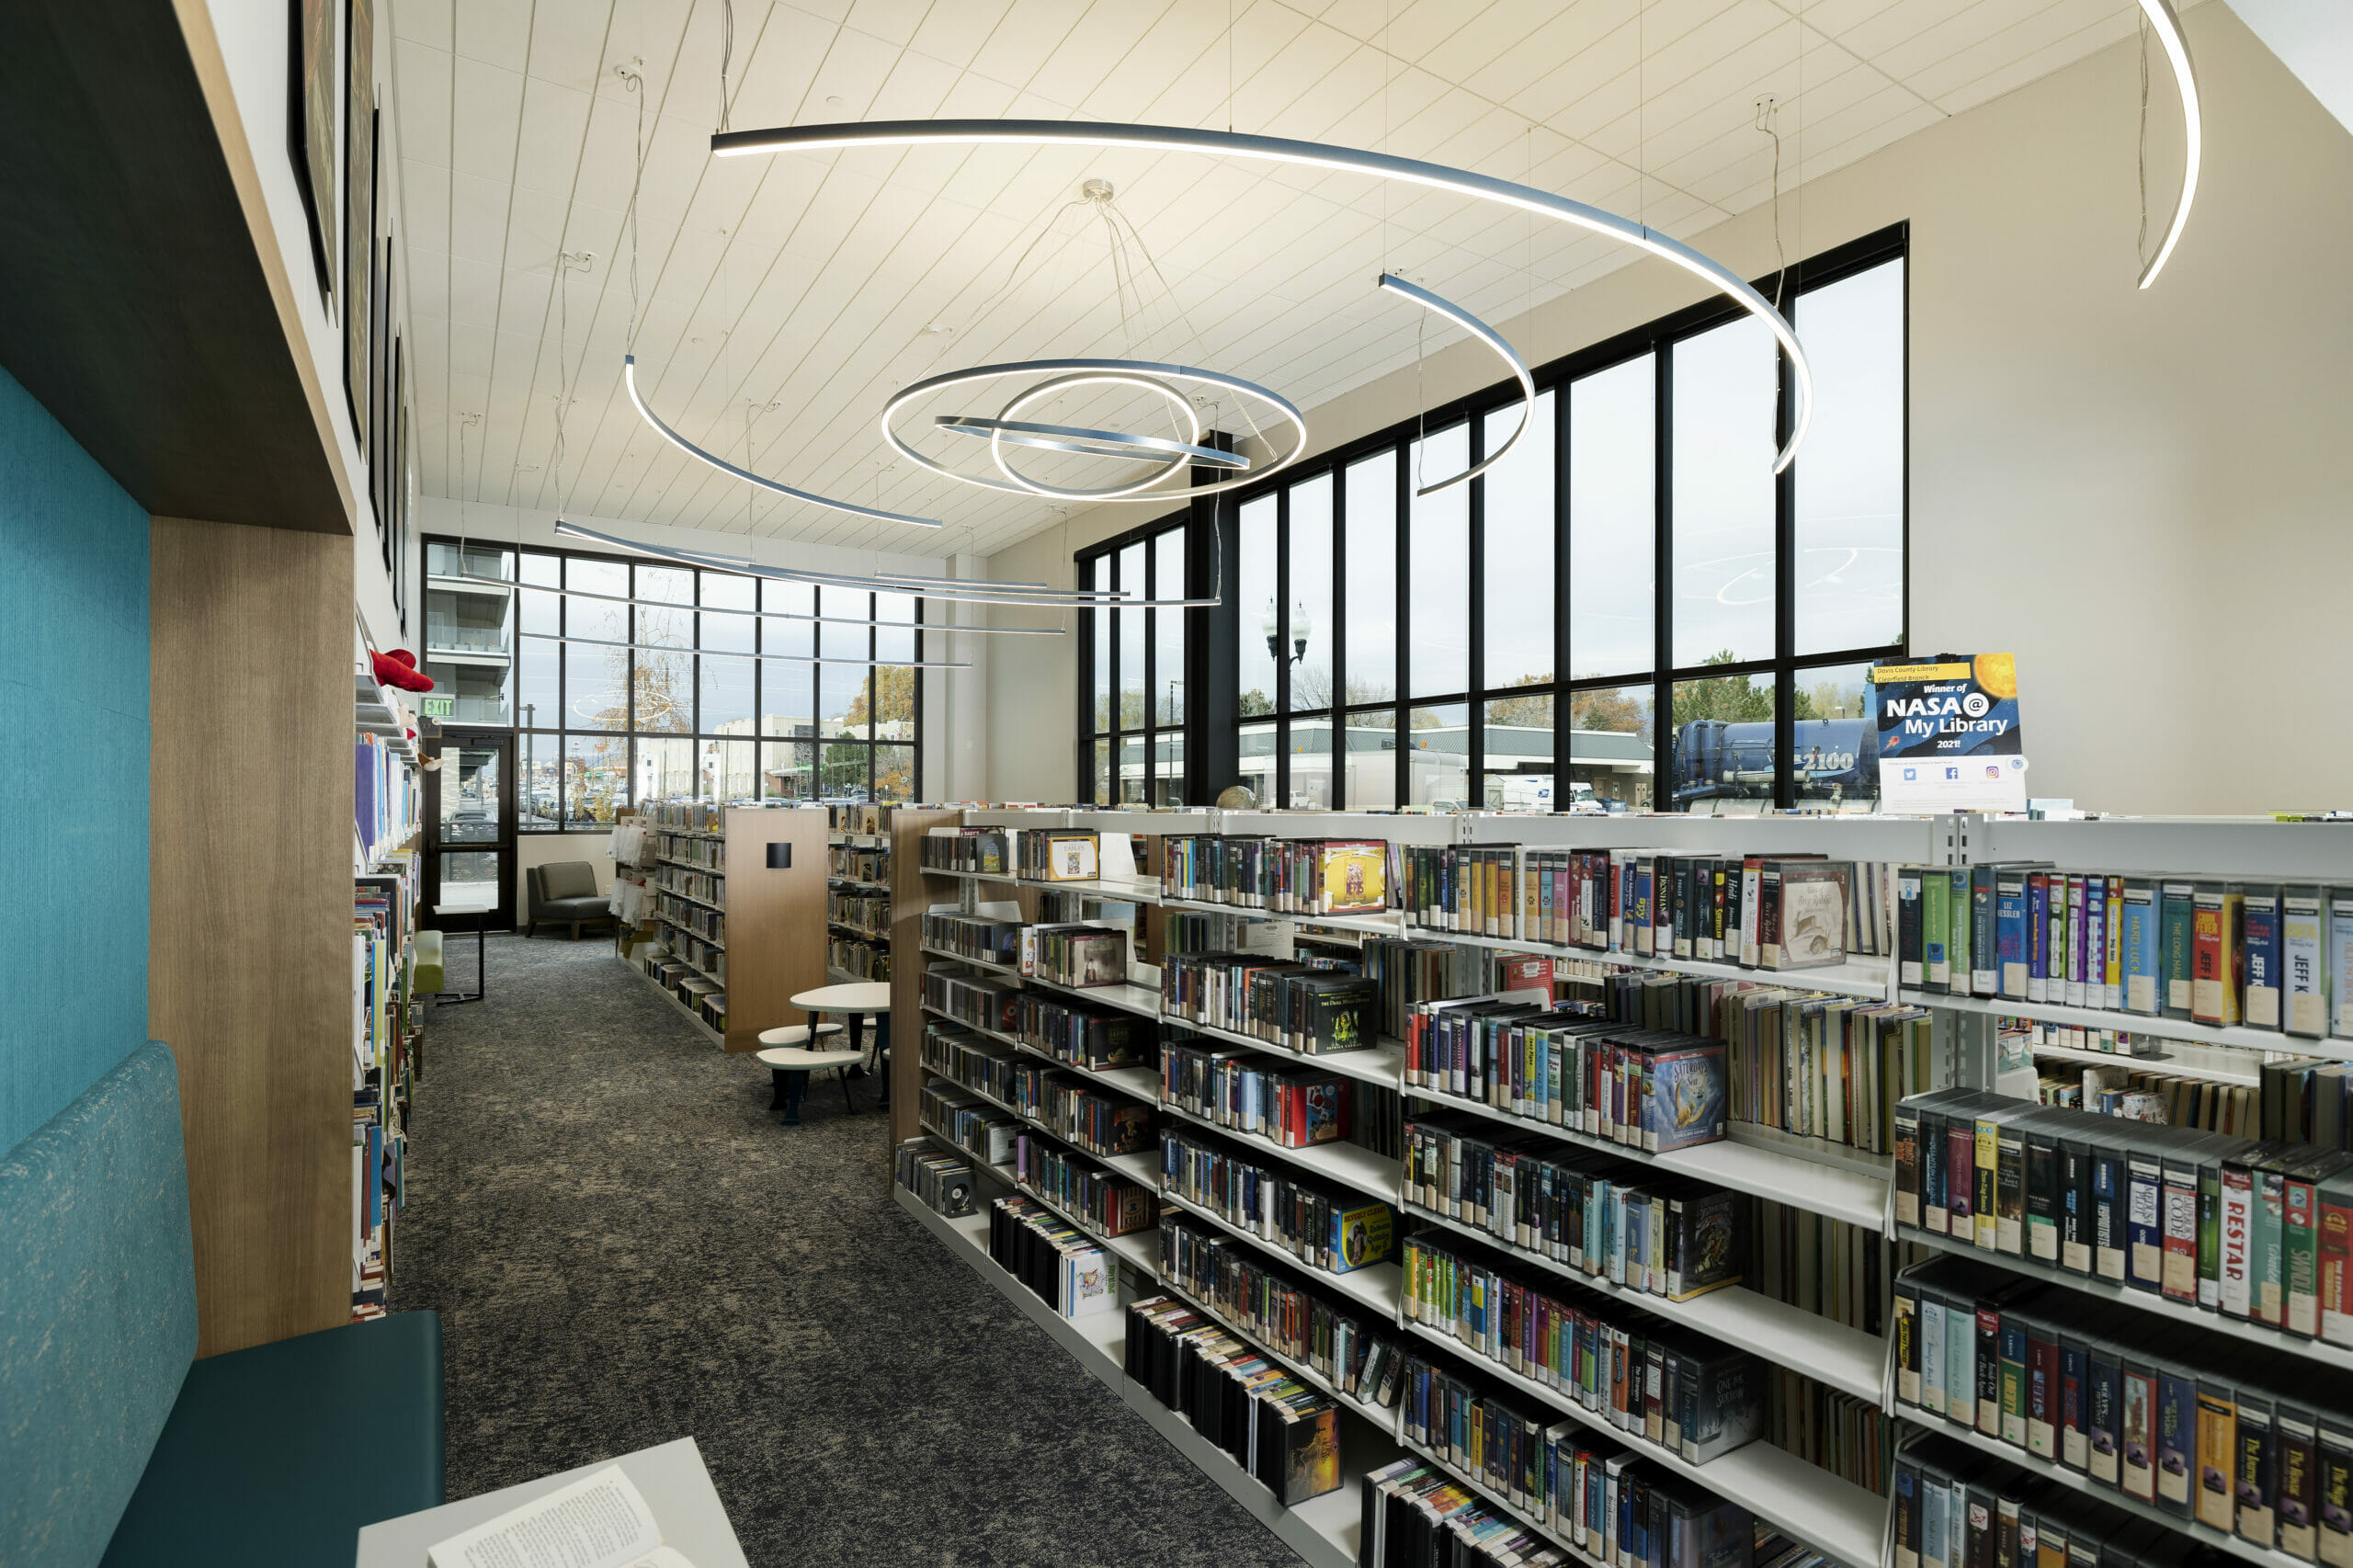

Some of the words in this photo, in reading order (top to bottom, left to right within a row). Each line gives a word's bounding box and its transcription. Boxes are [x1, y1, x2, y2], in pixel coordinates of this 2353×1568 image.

[1924, 685, 1955, 694] Winner
[1956, 683, 1968, 693] of
[425, 699, 452, 716] EXIT
[1905, 720, 1935, 738] My
[1939, 719, 2008, 736] Library
[1659, 875, 1668, 911] IRONHAN
[1728, 878, 1738, 901] Heidi
[2131, 916, 2141, 945] HARD
[2174, 922, 2182, 937] THE
[2196, 922, 2218, 935] FEVER
[2130, 947, 2140, 972] LUCK
[2173, 937, 2181, 960] LONG
[2200, 950, 2211, 973] JEFF
[2252, 953, 2265, 978] JEFF
[2295, 955, 2309, 982] JEFF
[1904, 1137, 1915, 1167] JUNGLE
[2135, 1190, 2146, 1215] PLOT
[2144, 1185, 2155, 1223] MEDUSA
[2097, 1205, 2110, 1246] HYPNOTISTS
[2170, 1197, 2185, 1237] CODE
[2226, 1201, 2245, 1280] RESTAR
[1987, 1362, 1996, 1381] Inside
[1717, 1380, 1730, 1393] ONE
[1978, 1380, 1986, 1397] Again
[1987, 1381, 1995, 1395] Out
[2004, 1373, 2017, 1415] LIBERTY
[2065, 1389, 2076, 1419] DASH
[2246, 1437, 2261, 1453] The
[2290, 1449, 2304, 1465] The
[2289, 1468, 2304, 1496] Rescue
[2332, 1466, 2348, 1482] The
